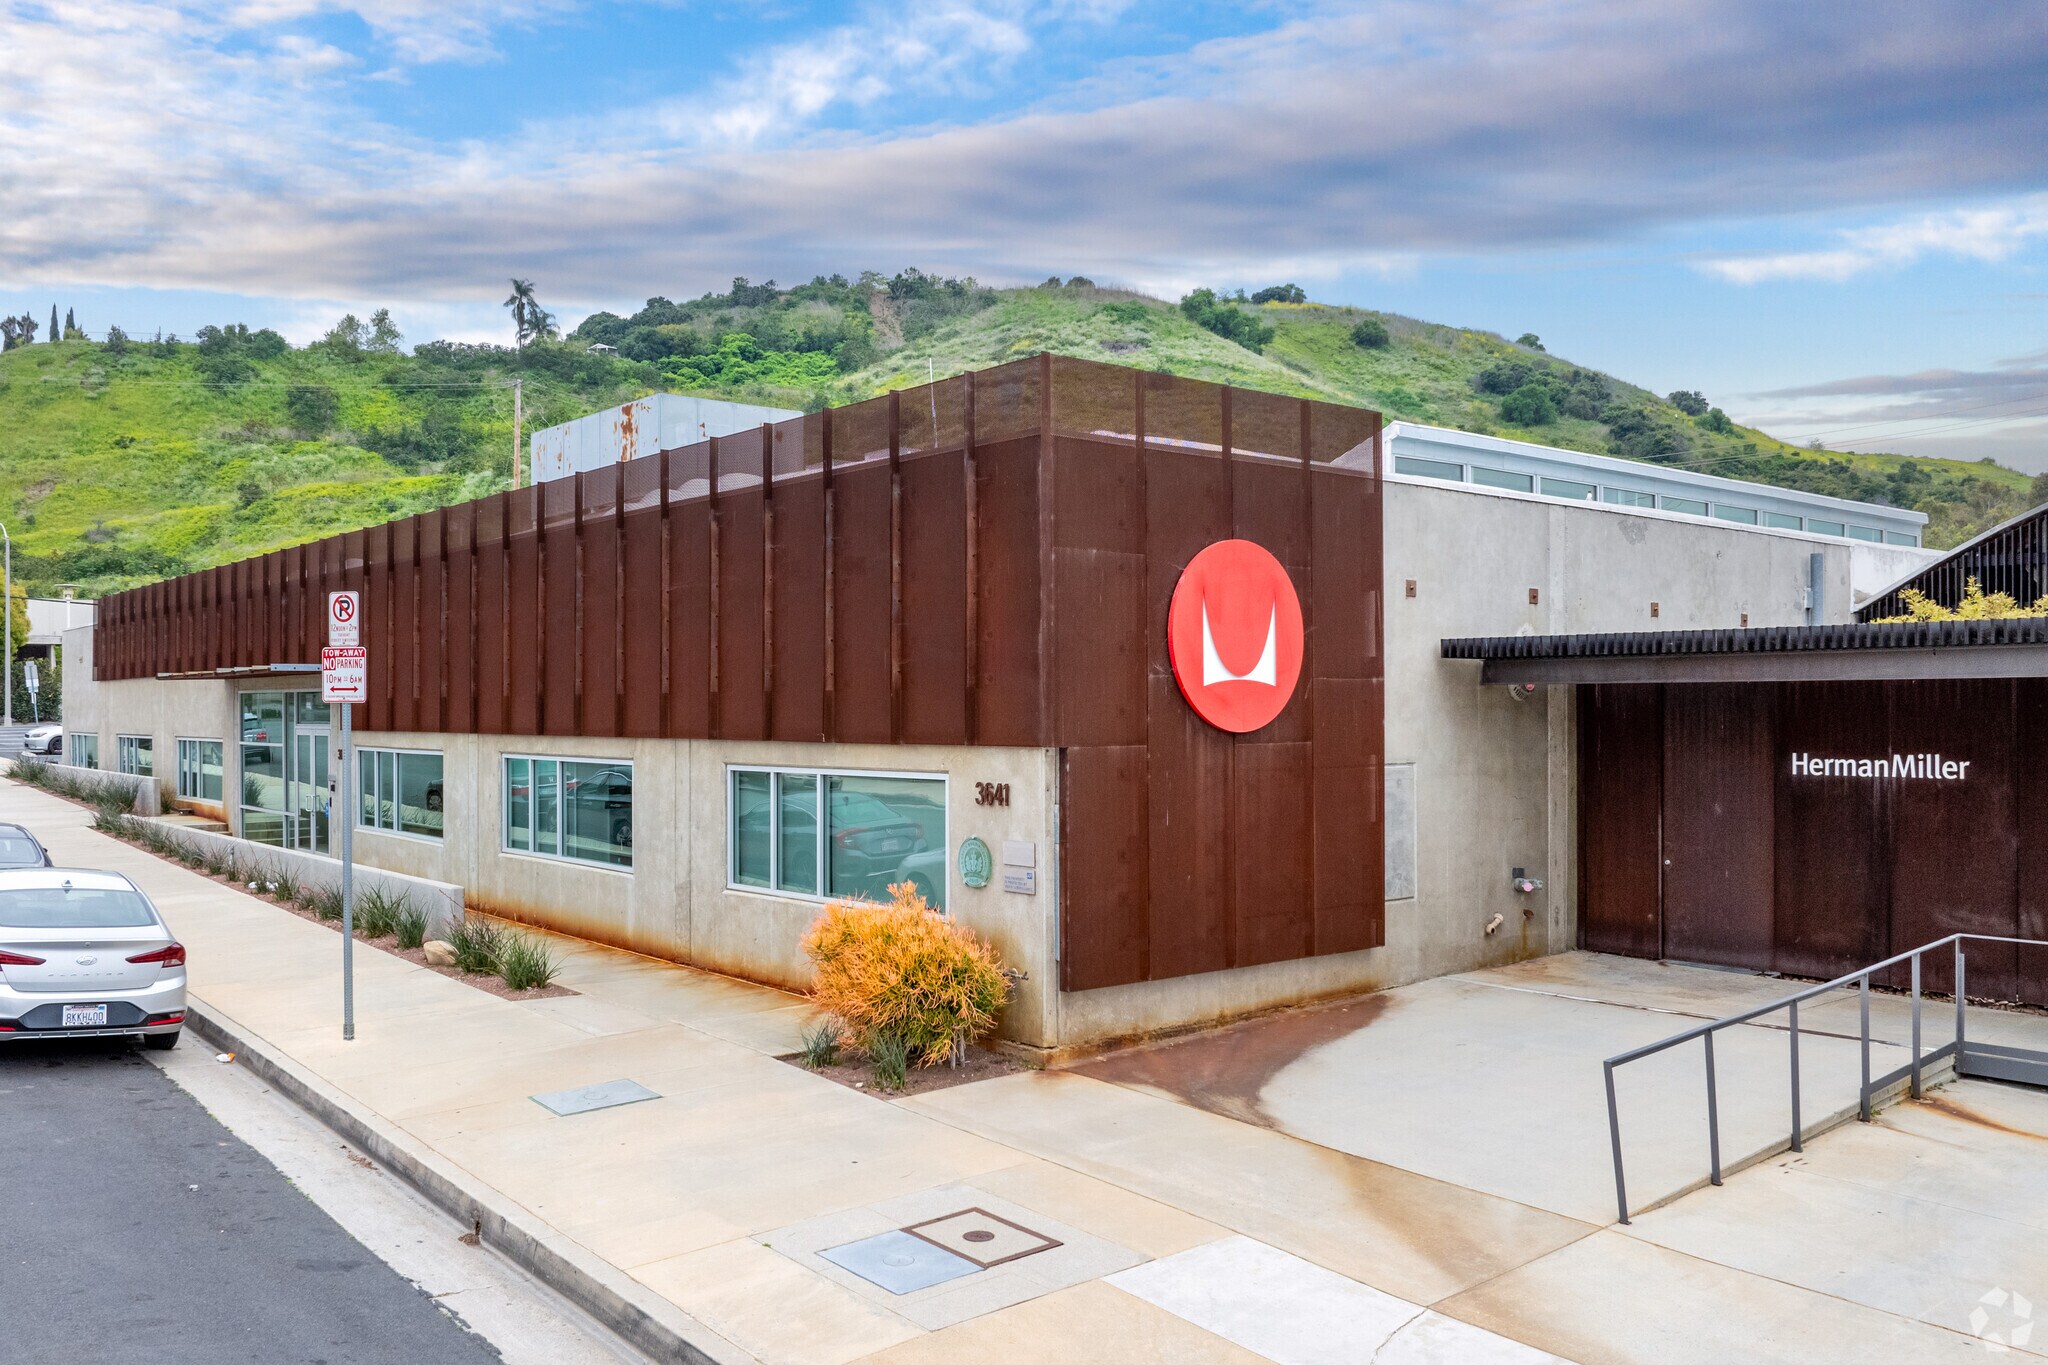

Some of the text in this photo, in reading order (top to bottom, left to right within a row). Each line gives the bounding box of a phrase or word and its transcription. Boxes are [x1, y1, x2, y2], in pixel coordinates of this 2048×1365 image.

[323, 658, 363, 669] NO PARKING
[326, 674, 342, 684] 10PM
[1791, 752, 1970, 780] HermanMiller
[974, 781, 1011, 807] 3641
